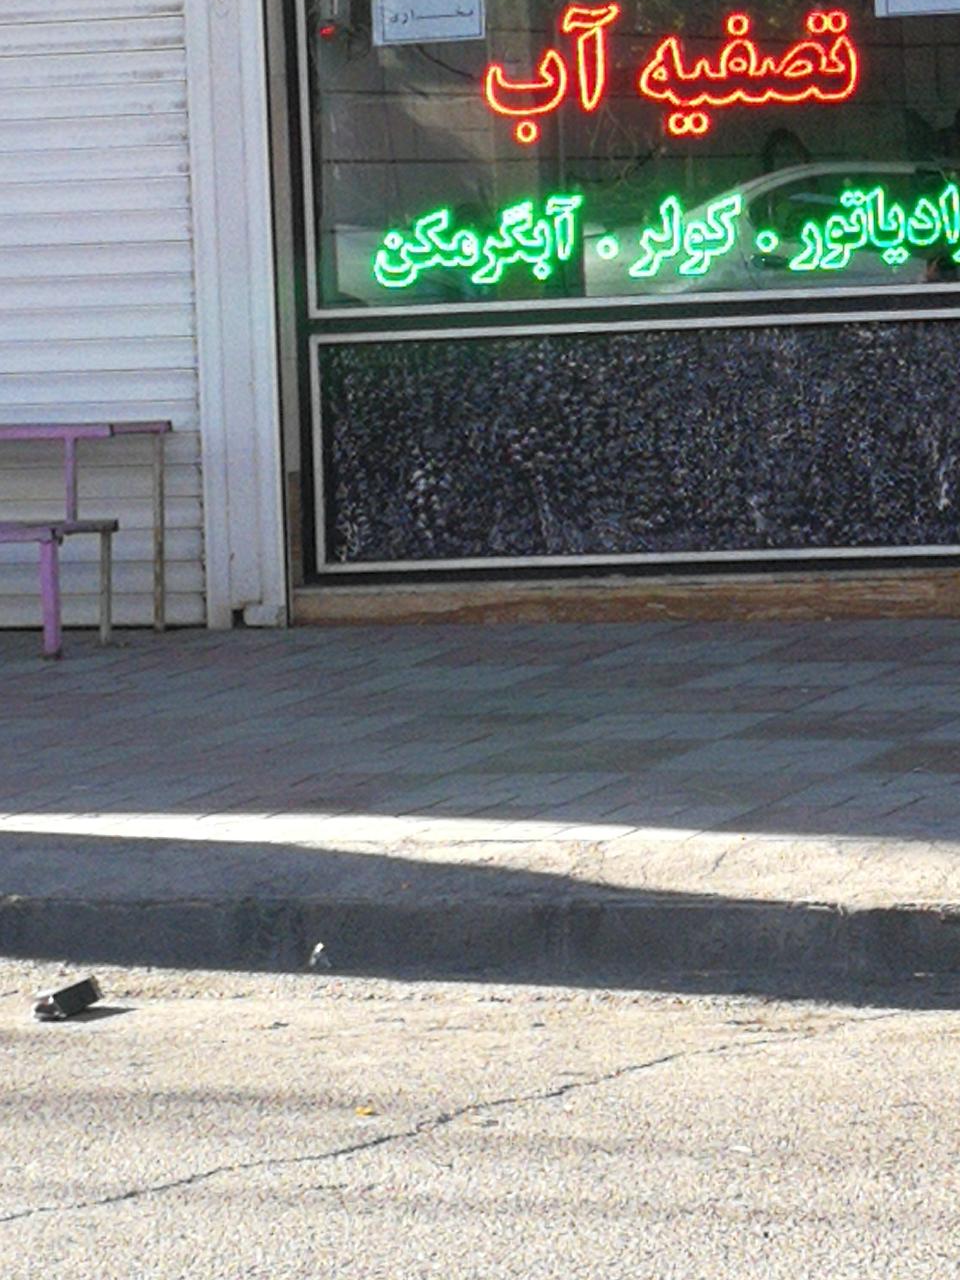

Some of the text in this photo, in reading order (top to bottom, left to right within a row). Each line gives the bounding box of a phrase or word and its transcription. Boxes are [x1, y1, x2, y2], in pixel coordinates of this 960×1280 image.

[486, 4, 858, 143] تصفیه آب
[374, 192, 584, 287] آبگرمکن
[629, 195, 743, 276] کولر
